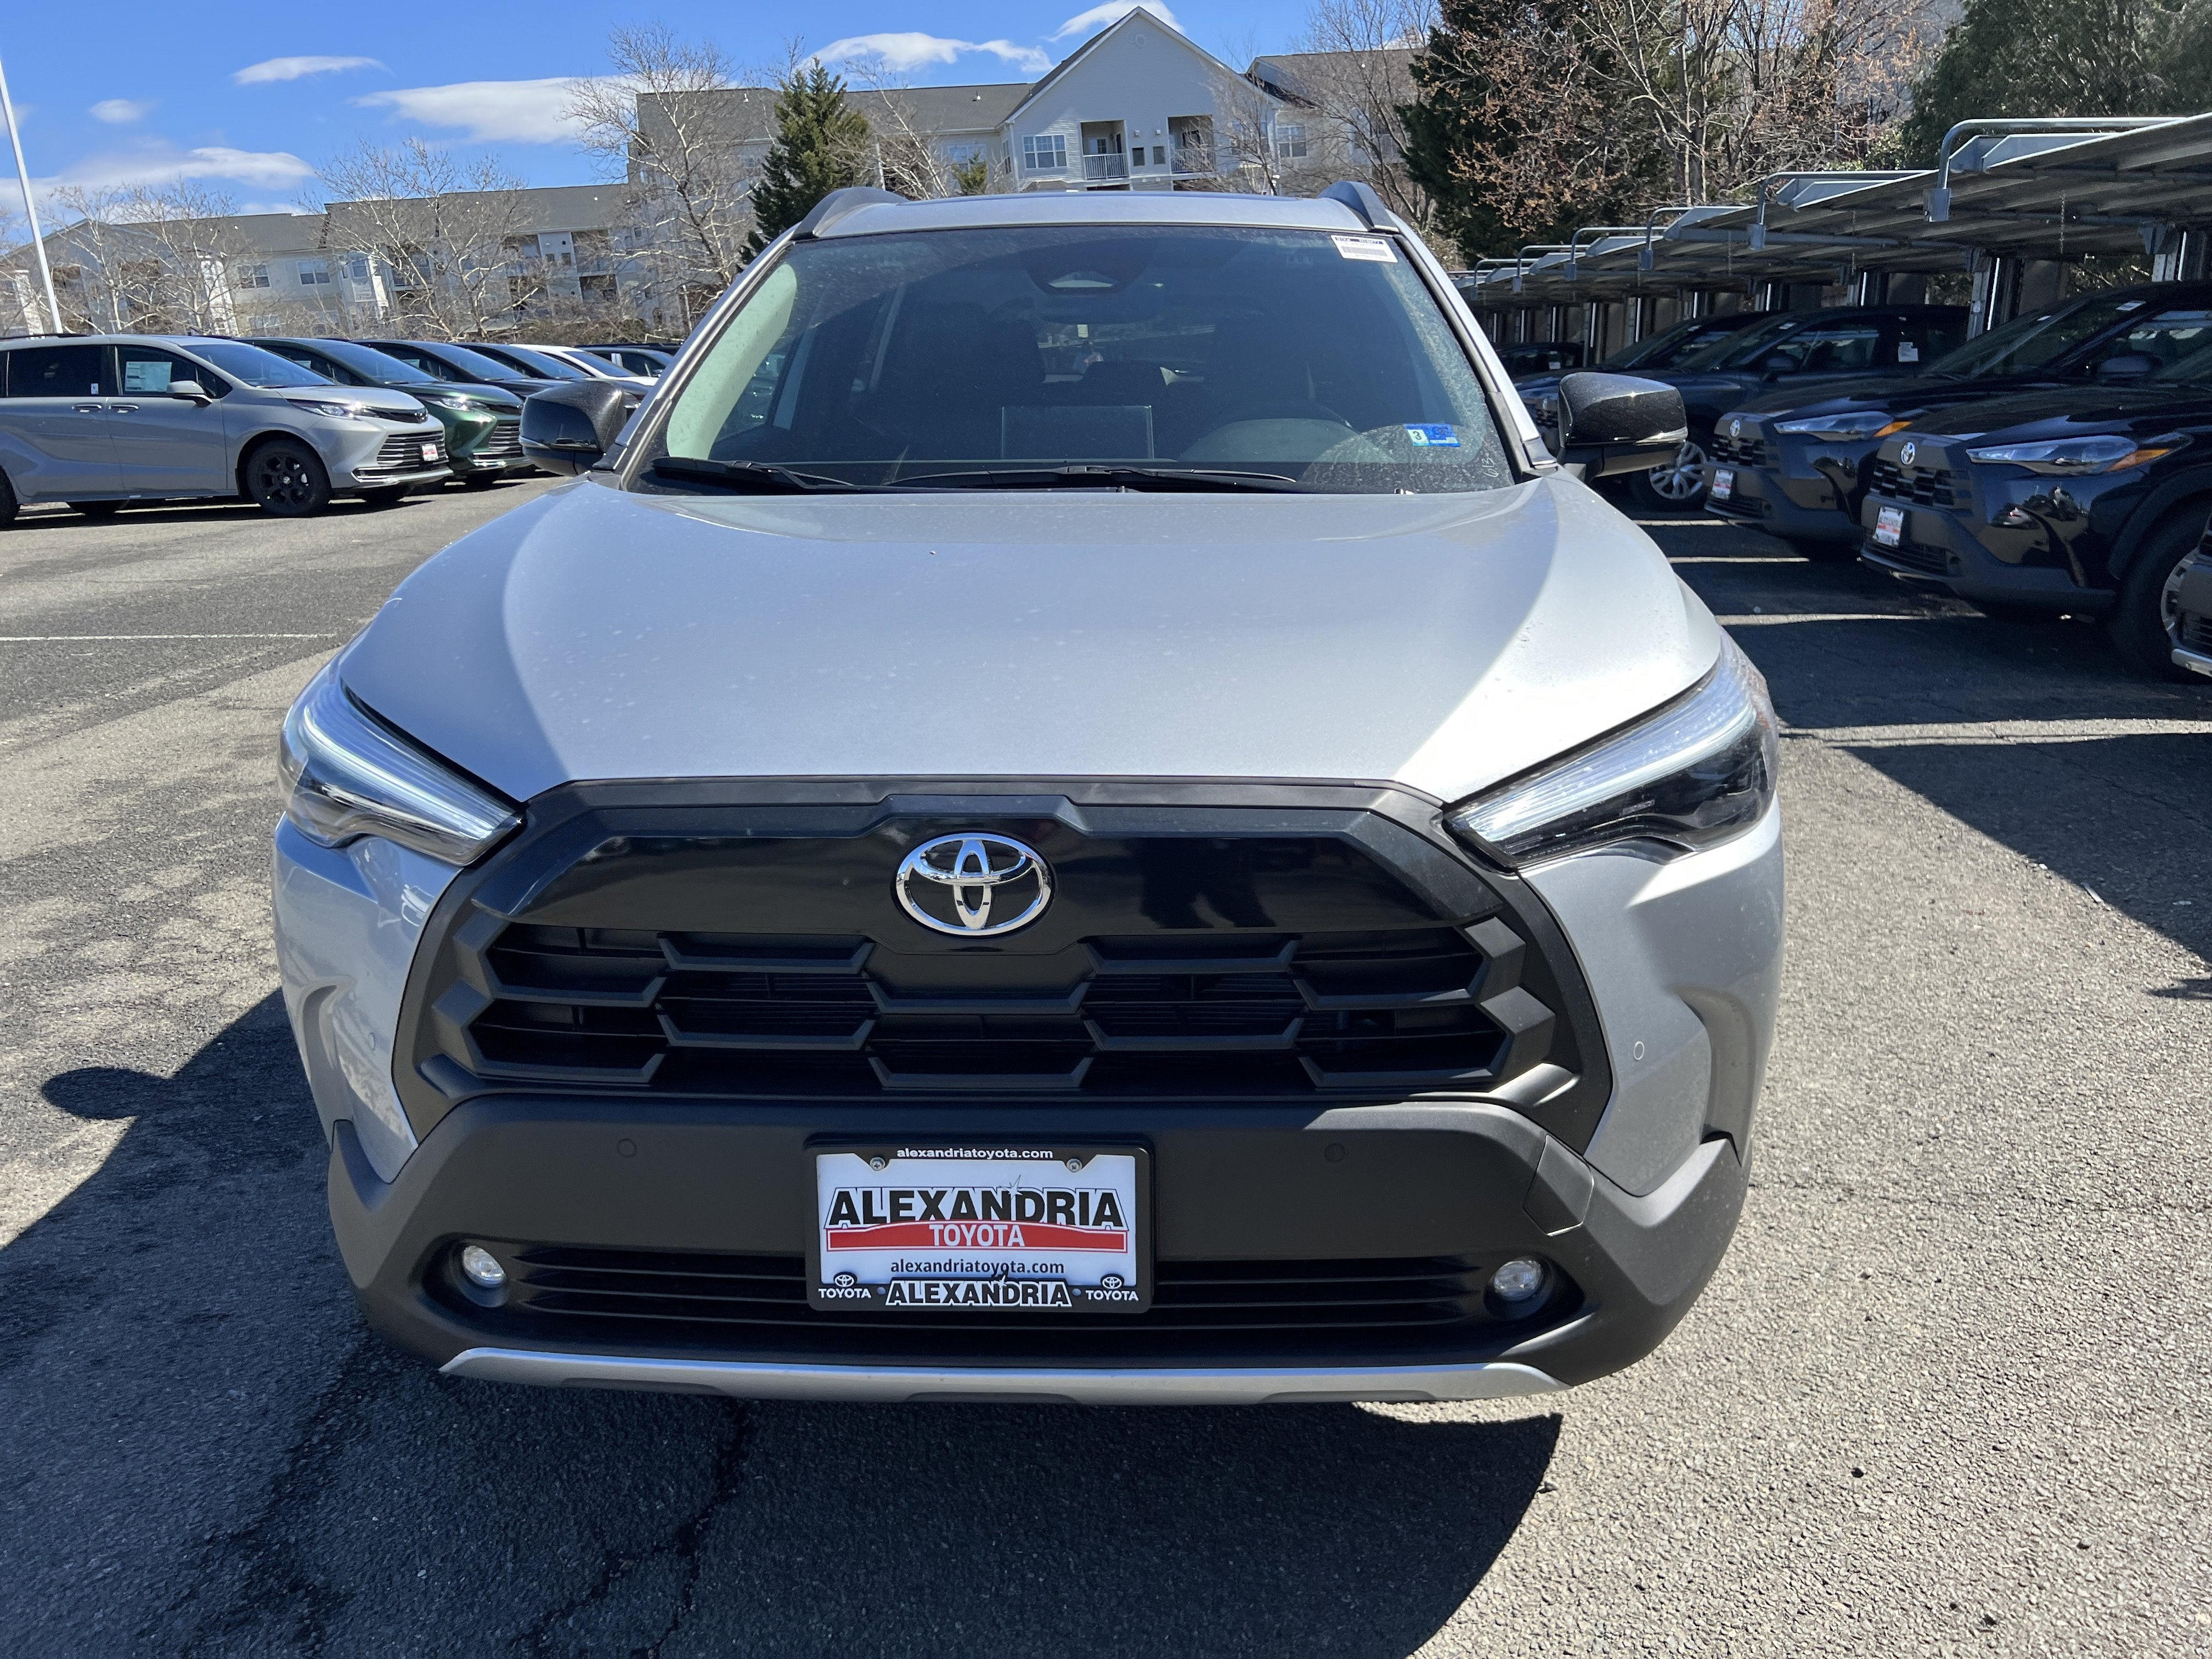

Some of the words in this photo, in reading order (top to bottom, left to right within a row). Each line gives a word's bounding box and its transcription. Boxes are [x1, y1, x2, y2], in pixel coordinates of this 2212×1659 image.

[1413, 431, 1422, 440] 3
[896, 1148, 1054, 1160] alexandriatoyota.com
[828, 1189, 1125, 1227] ALEXANDRIA
[929, 1223, 1025, 1247] TOYOTA
[890, 1259, 1064, 1277] alexandriatoyota.com
[818, 1288, 871, 1299] TOYOTA
[885, 1280, 1072, 1307] ALEXANDRIA
[1085, 1290, 1139, 1301] TOYOTA
